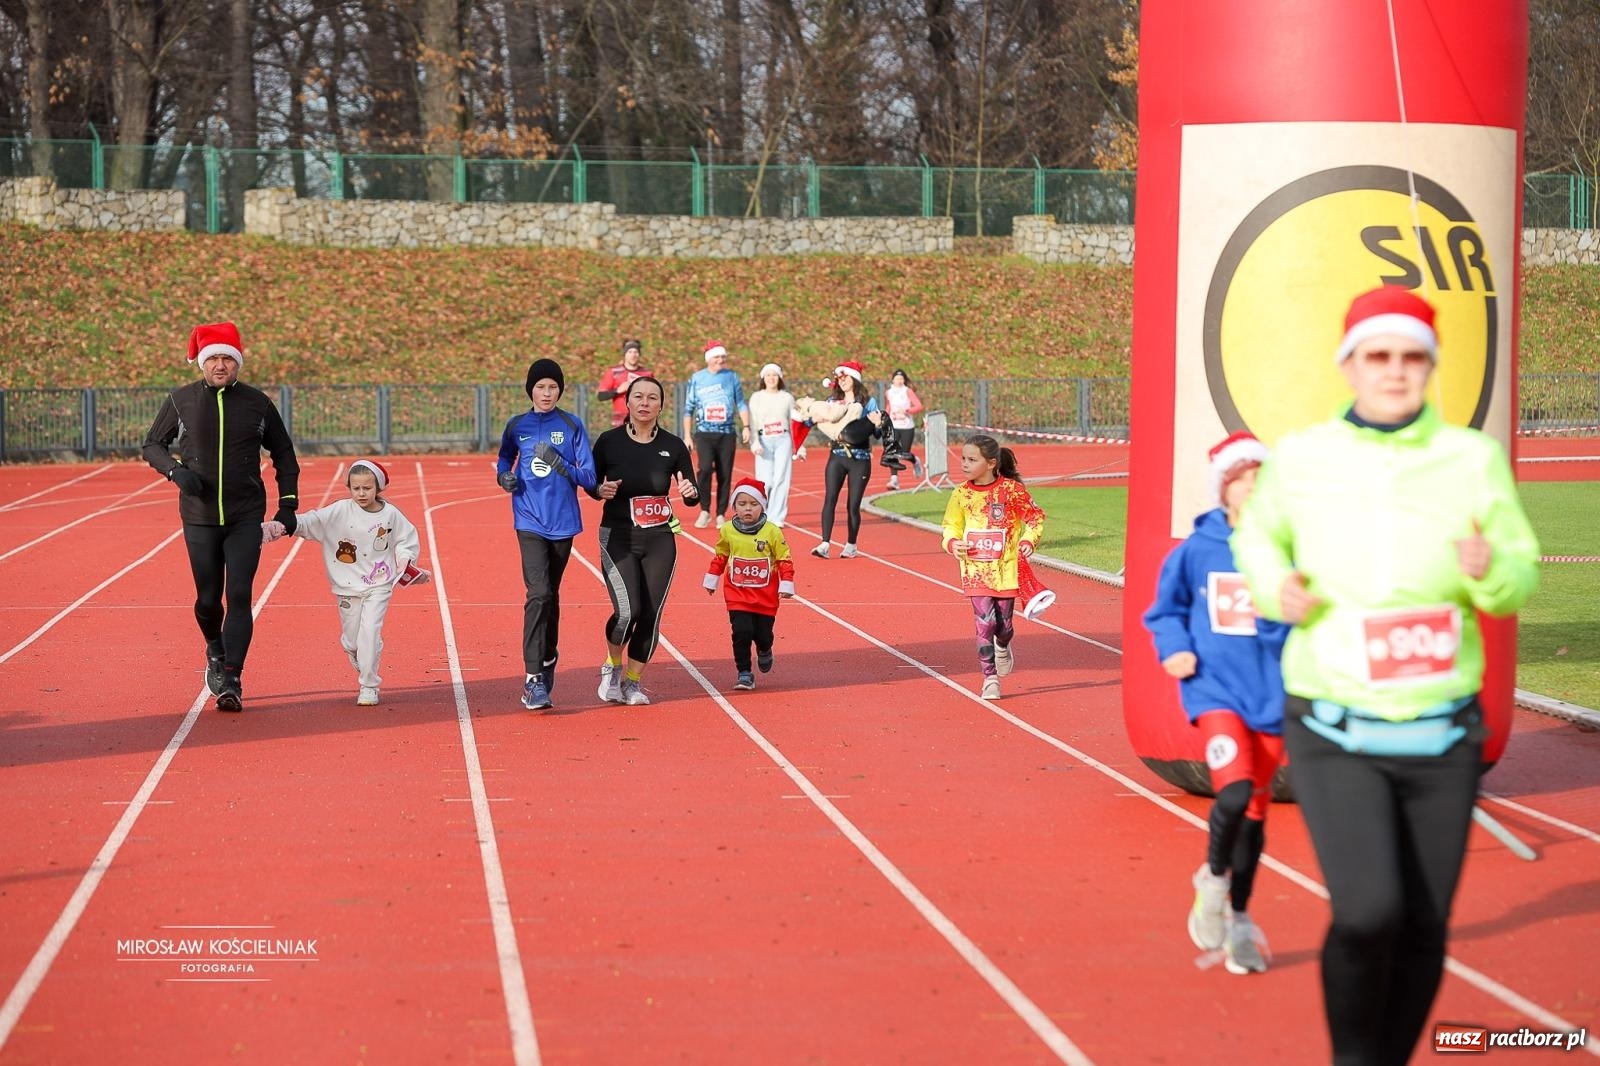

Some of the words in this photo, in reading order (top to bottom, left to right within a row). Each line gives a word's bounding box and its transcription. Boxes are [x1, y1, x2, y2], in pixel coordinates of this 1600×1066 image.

[1361, 225, 1495, 291] SIR
[645, 503, 661, 515] 50
[975, 538, 993, 550] 49
[742, 565, 759, 577] 48
